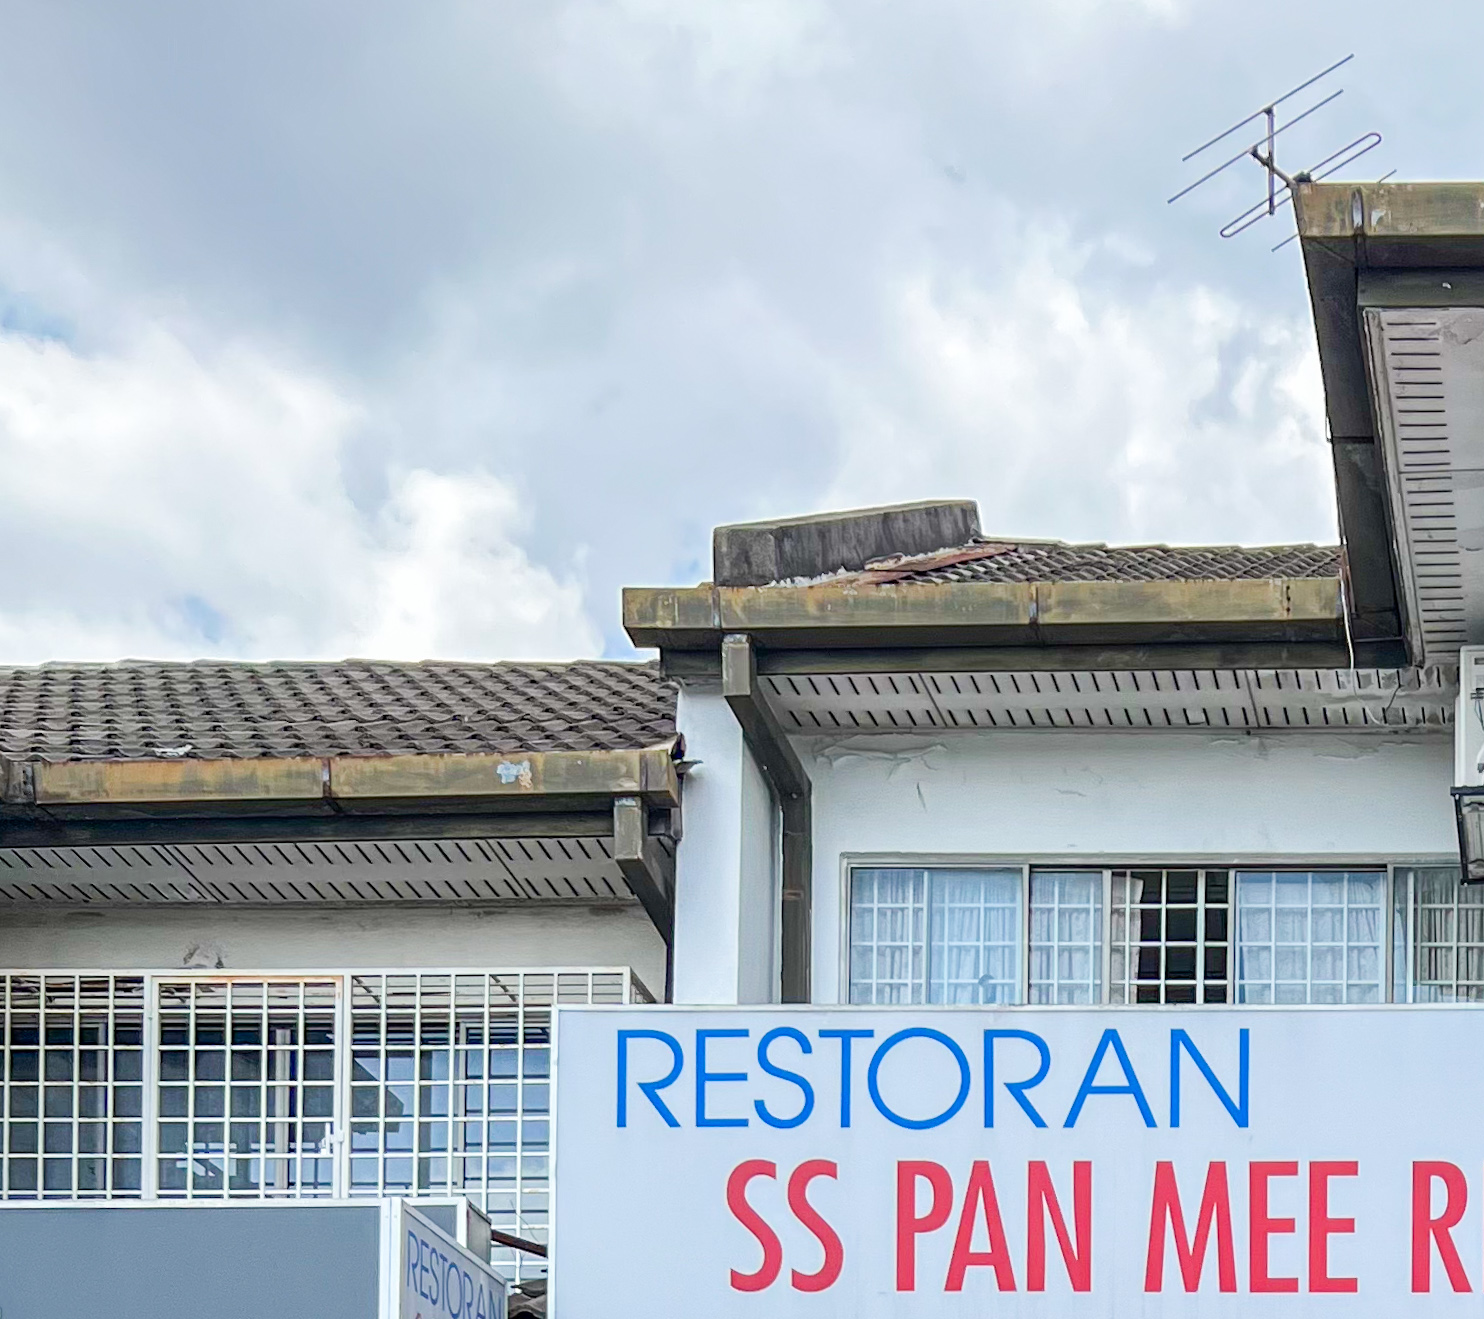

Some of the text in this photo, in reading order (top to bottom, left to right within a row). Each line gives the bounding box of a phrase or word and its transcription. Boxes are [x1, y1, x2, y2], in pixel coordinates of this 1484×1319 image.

[617, 1027, 1249, 1130] RESTORAN
[727, 1159, 843, 1292] SS
[896, 1160, 1092, 1293] PAN
[1144, 1161, 1359, 1293] MEE
